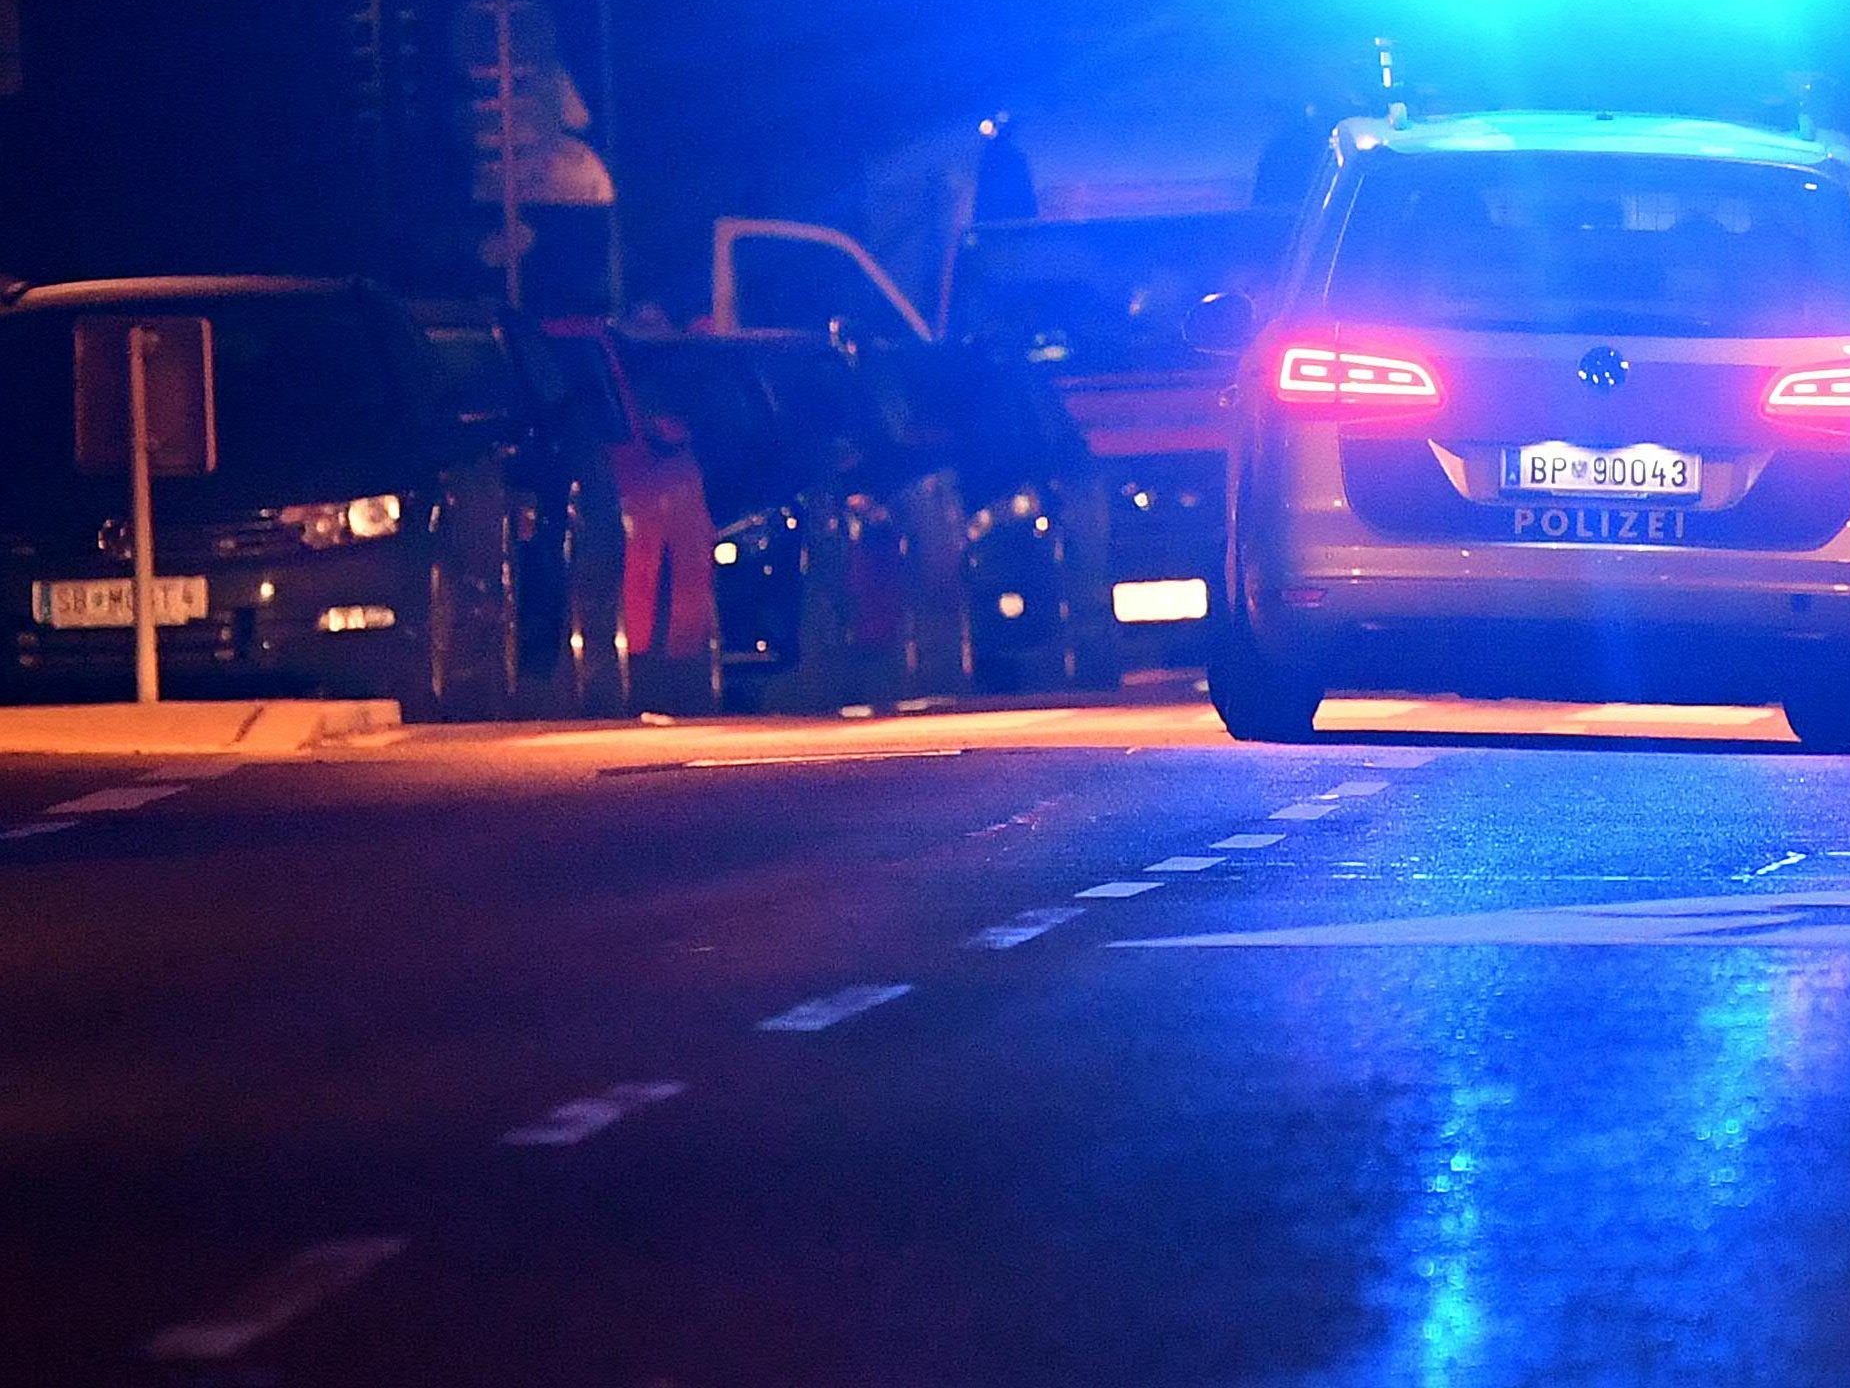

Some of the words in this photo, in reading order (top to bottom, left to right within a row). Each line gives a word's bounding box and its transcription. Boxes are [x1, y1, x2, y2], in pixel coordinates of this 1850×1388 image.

[1530, 456, 1567, 484] BP
[1593, 456, 1688, 487] 90043
[1513, 508, 1684, 539] POLIZEI
